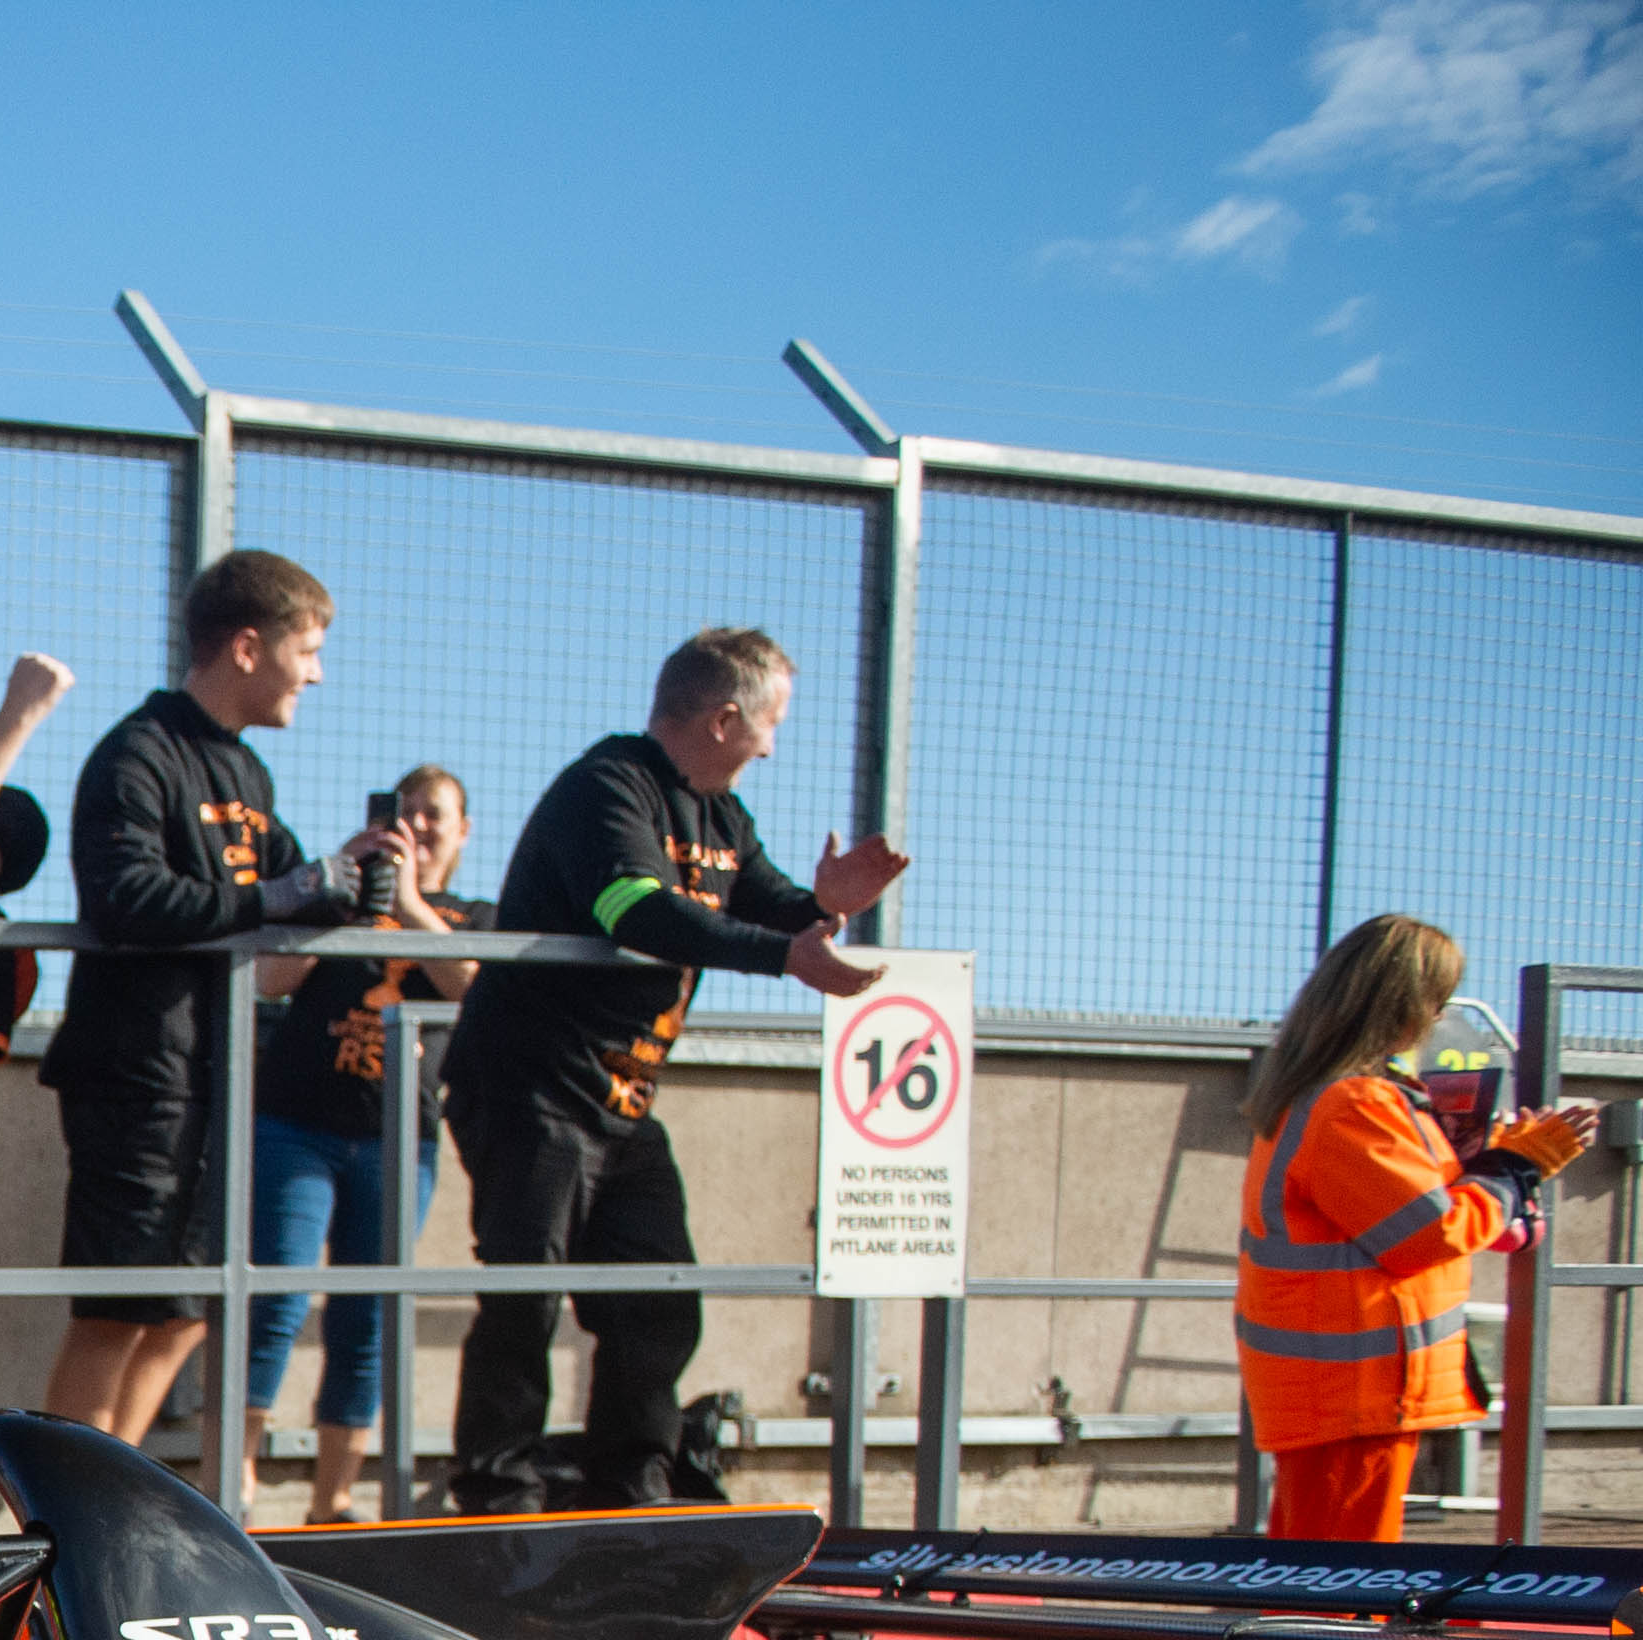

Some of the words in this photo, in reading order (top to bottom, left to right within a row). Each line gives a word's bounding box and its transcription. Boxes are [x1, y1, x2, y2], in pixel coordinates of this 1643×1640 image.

[334, 1038, 386, 1081] RS
[854, 1038, 939, 1111] 16
[841, 1165, 866, 1183] NO
[870, 1166, 949, 1183] PERSONS
[835, 1190, 894, 1208] UNDER
[921, 1191, 953, 1209] YRS
[836, 1214, 930, 1232] PERMITTED
[934, 1215, 951, 1231] IN
[829, 1239, 899, 1257] PITLANE
[902, 1240, 956, 1257] AREAS
